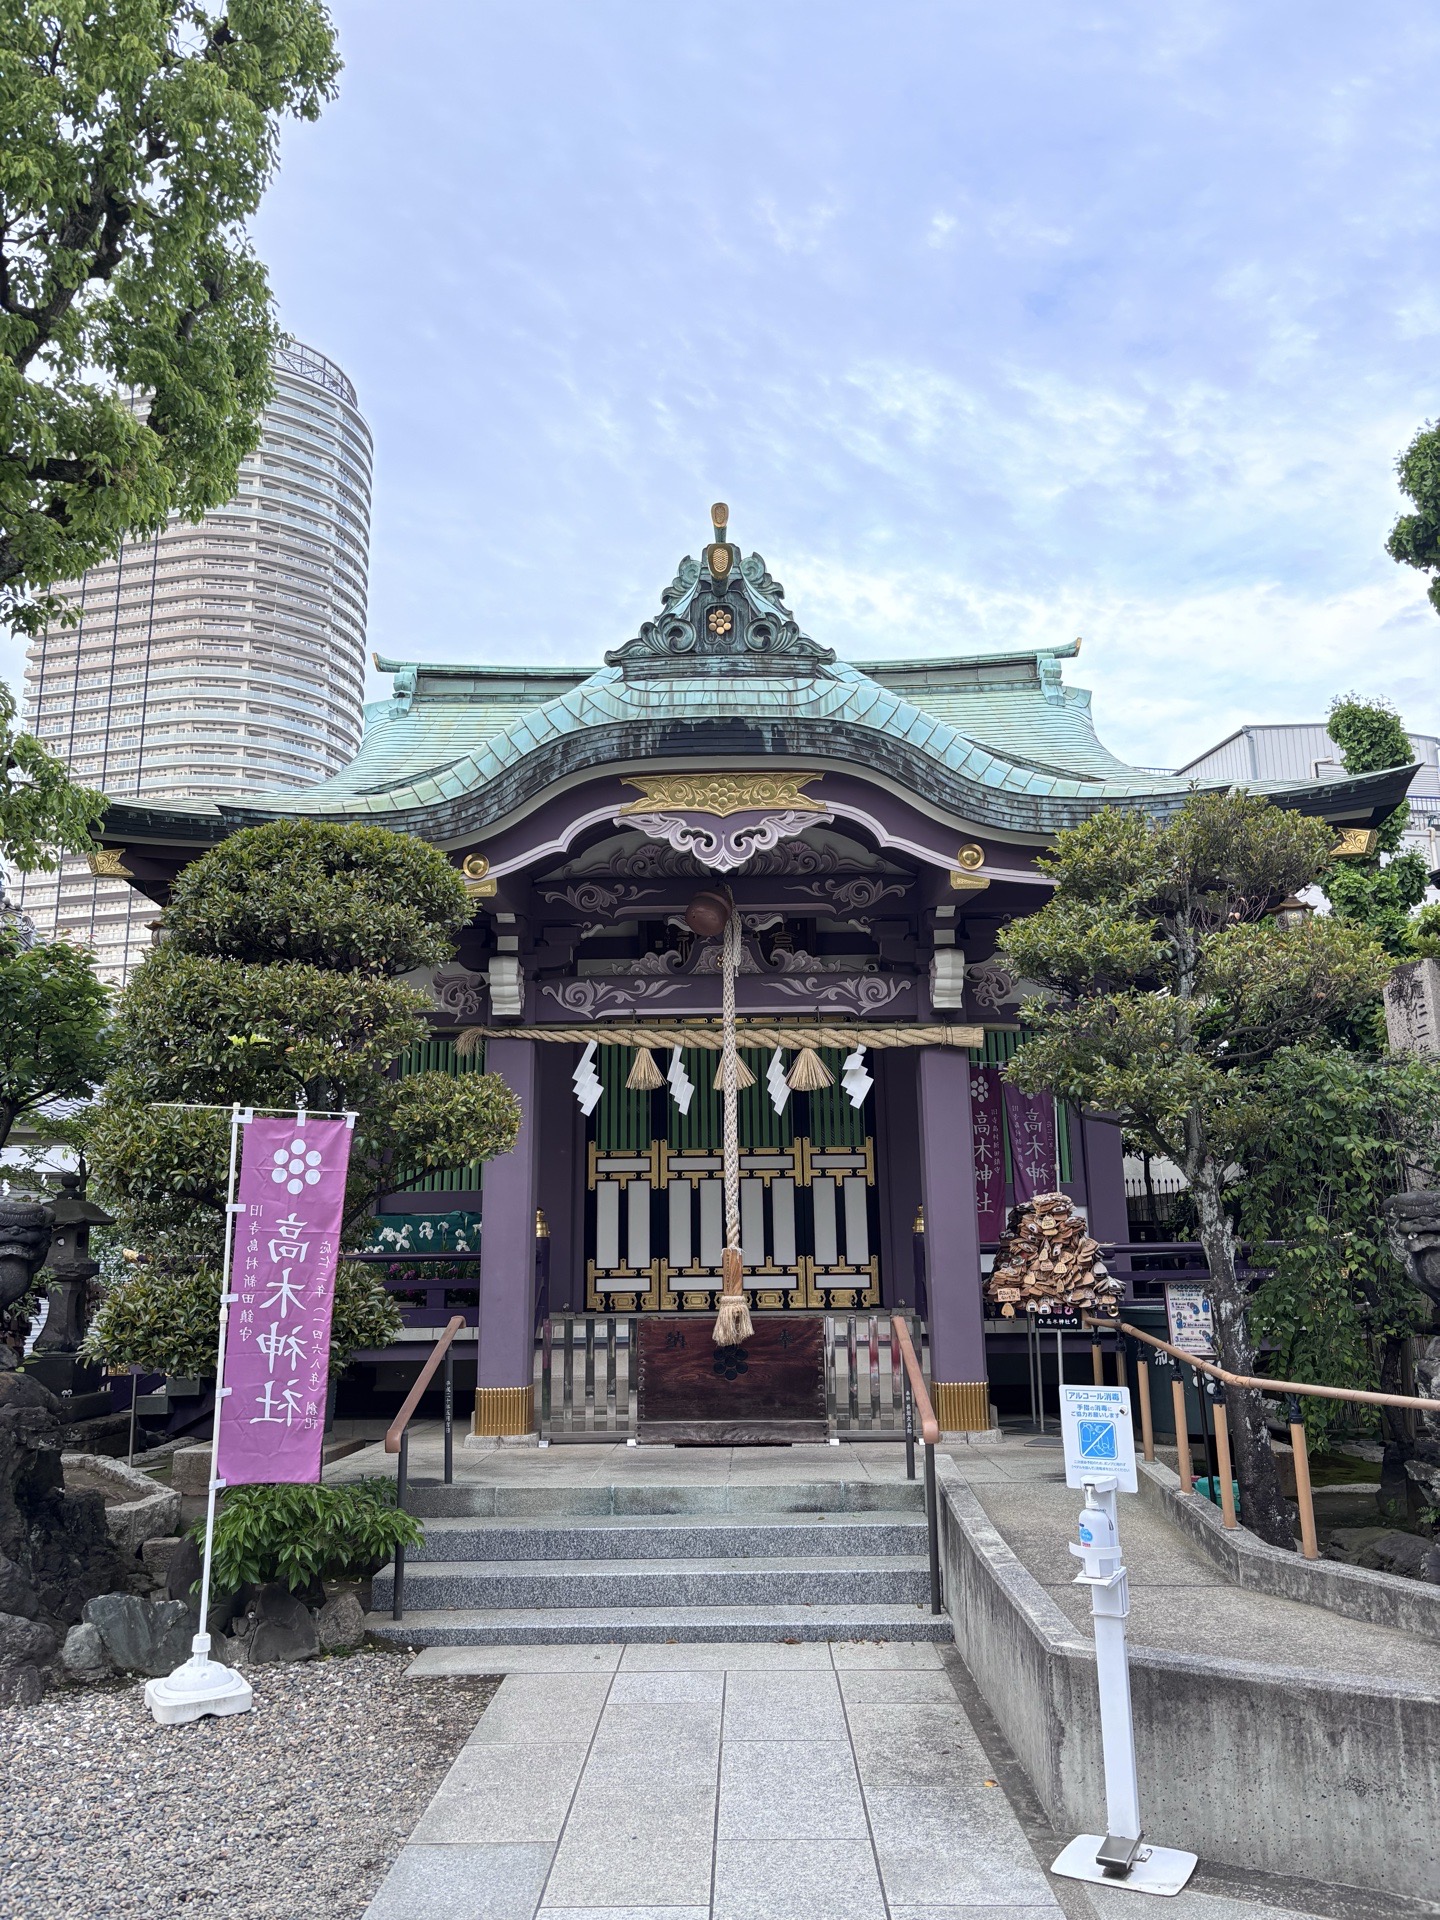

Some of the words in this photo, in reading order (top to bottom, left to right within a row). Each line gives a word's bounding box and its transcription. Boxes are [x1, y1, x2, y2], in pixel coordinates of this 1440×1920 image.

[972, 1109, 995, 1213] 高木神社
[1068, 1391, 1120, 1402] アルコール消毒
[1076, 1403, 1112, 1412] 手指の消毒に
[1070, 1411, 1120, 1419] ご協力お願いします
